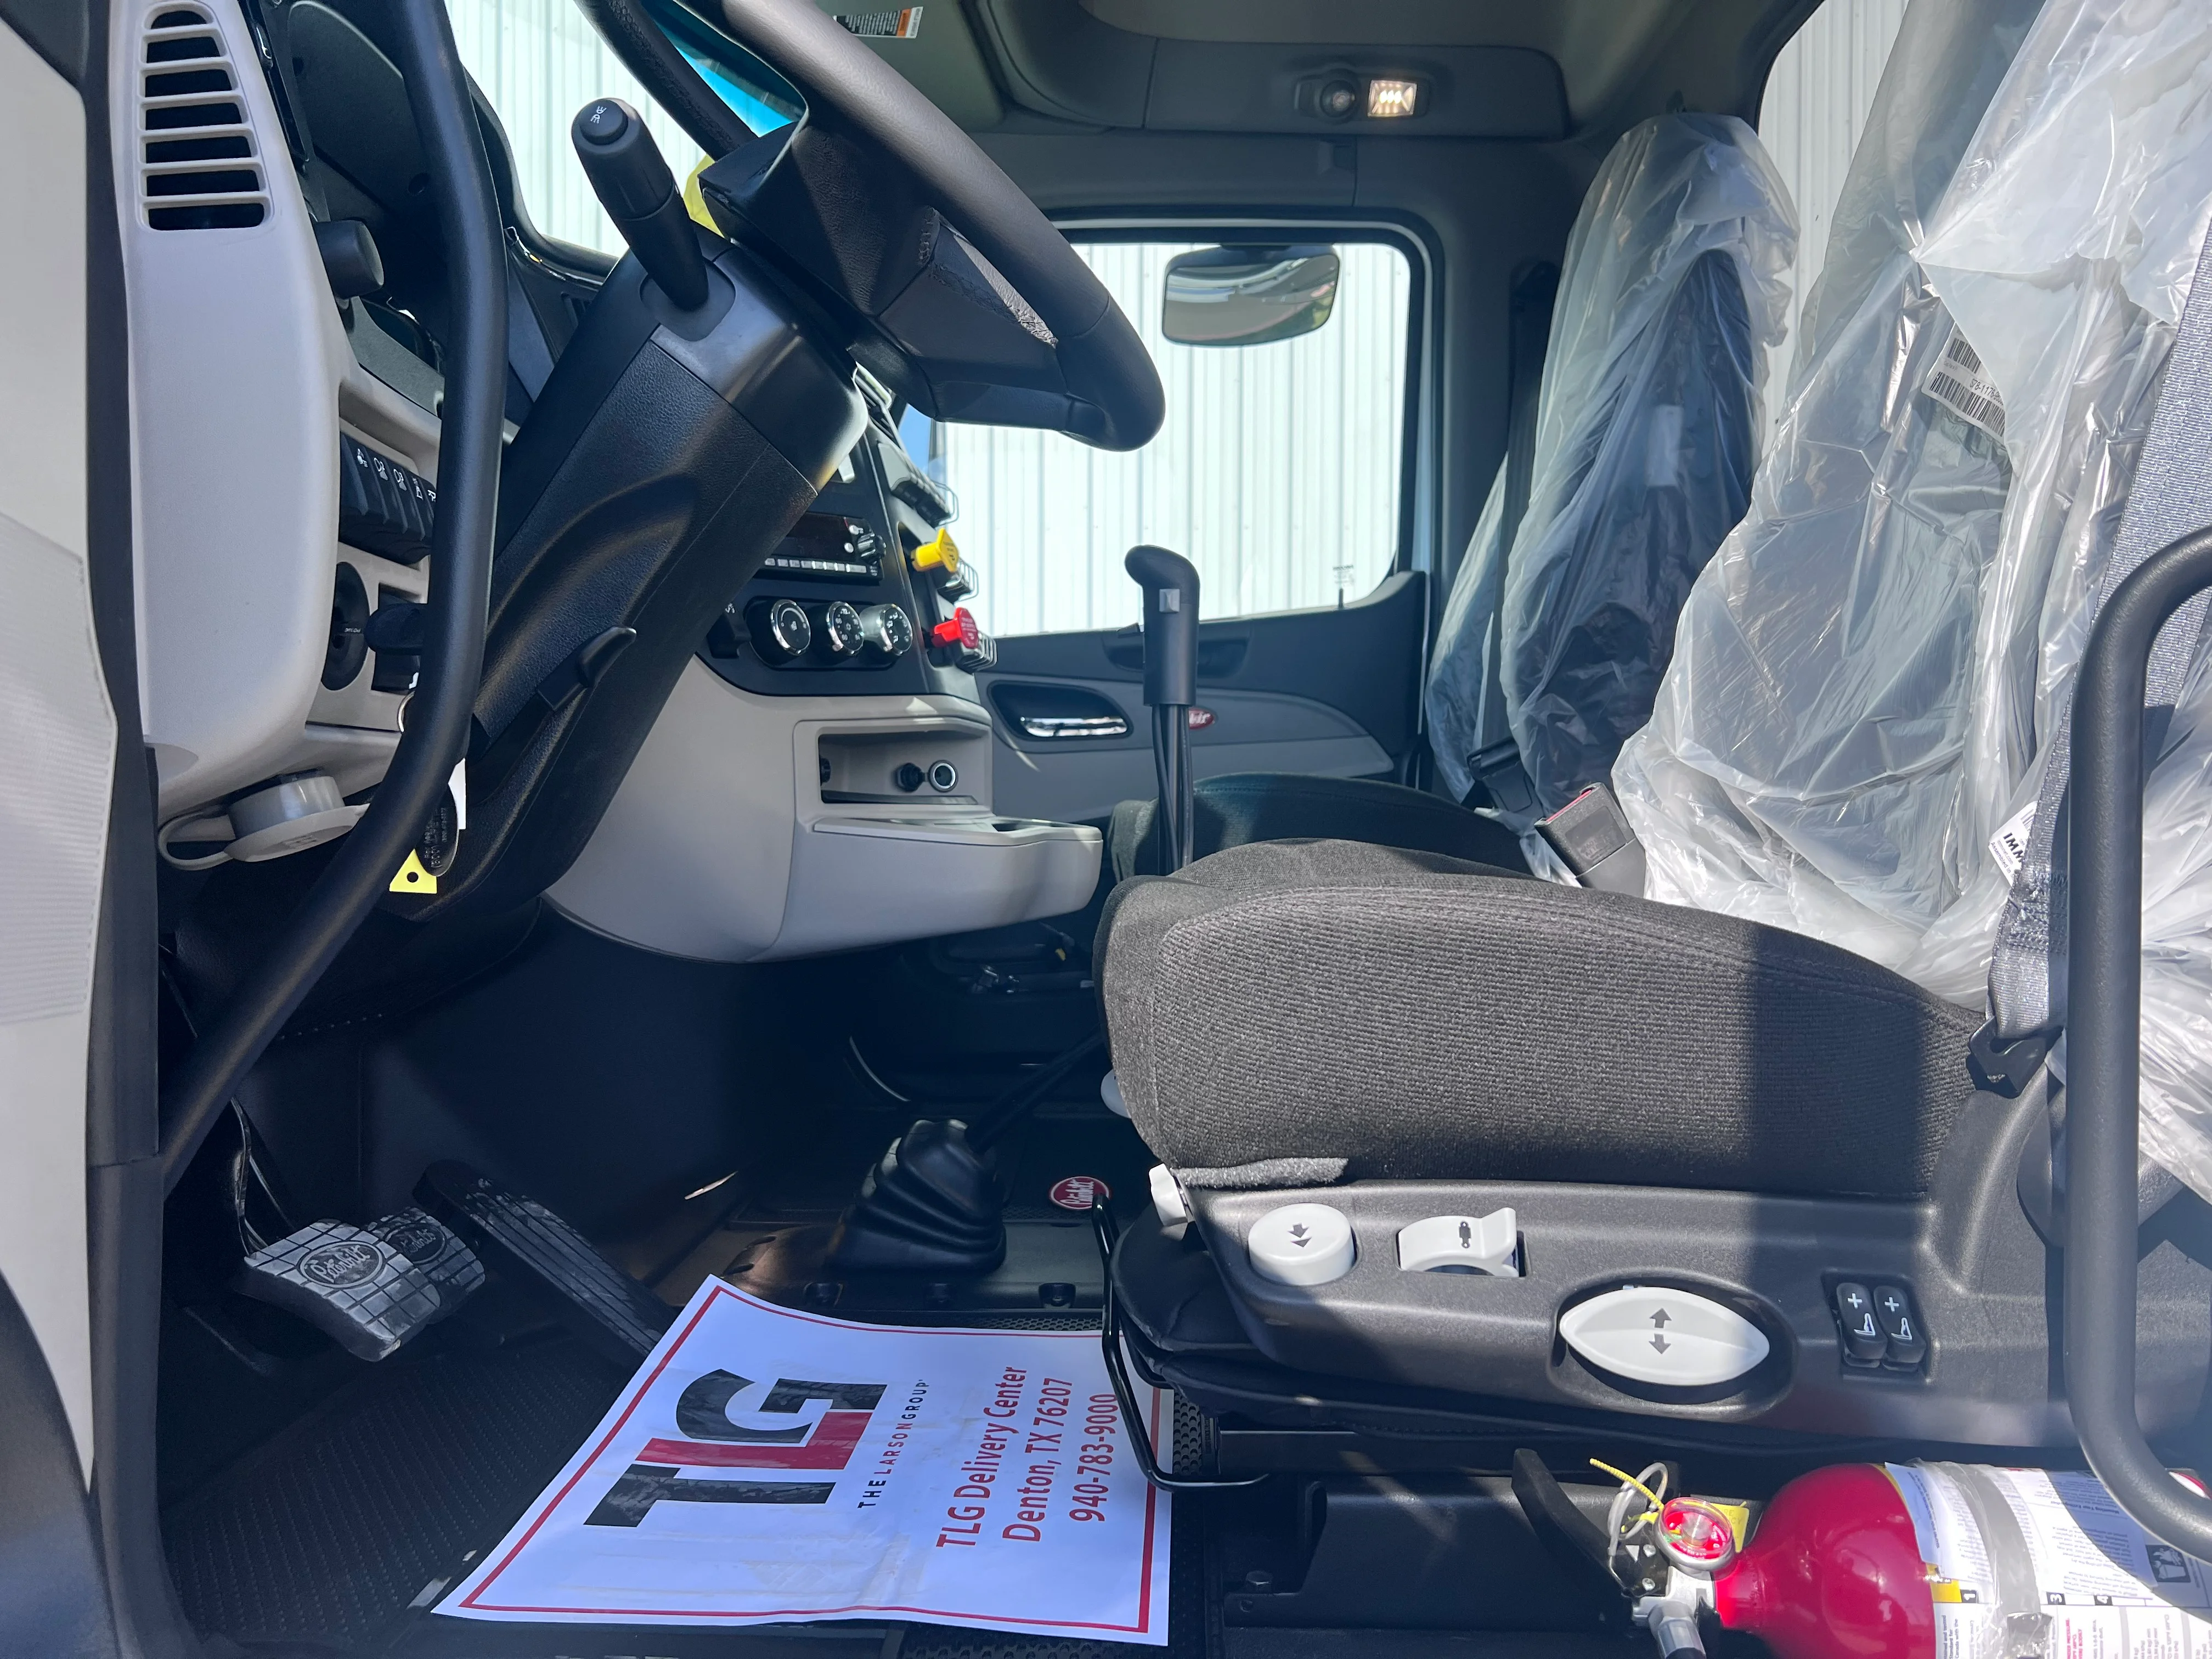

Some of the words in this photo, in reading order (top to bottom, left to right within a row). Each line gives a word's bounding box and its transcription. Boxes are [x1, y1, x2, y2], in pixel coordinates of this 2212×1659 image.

[1990, 842, 2008, 868] Assembled
[313, 1244, 371, 1284] Peterbilt
[983, 1365, 1027, 1418] Center
[1032, 1378, 1073, 1426] 76207
[583, 1368, 888, 1528] TLG
[857, 1480, 887, 1509] THE
[874, 1423, 913, 1475] LARSON
[901, 1380, 931, 1419] GROUP
[953, 1422, 1019, 1498] Delivery
[1024, 1432, 1062, 1453] TX
[1069, 1393, 1119, 1521] 940-783-9000
[1002, 1459, 1062, 1542] Denton,
[936, 1506, 985, 1548] TLG
[2050, 1593, 2063, 1604] 3
